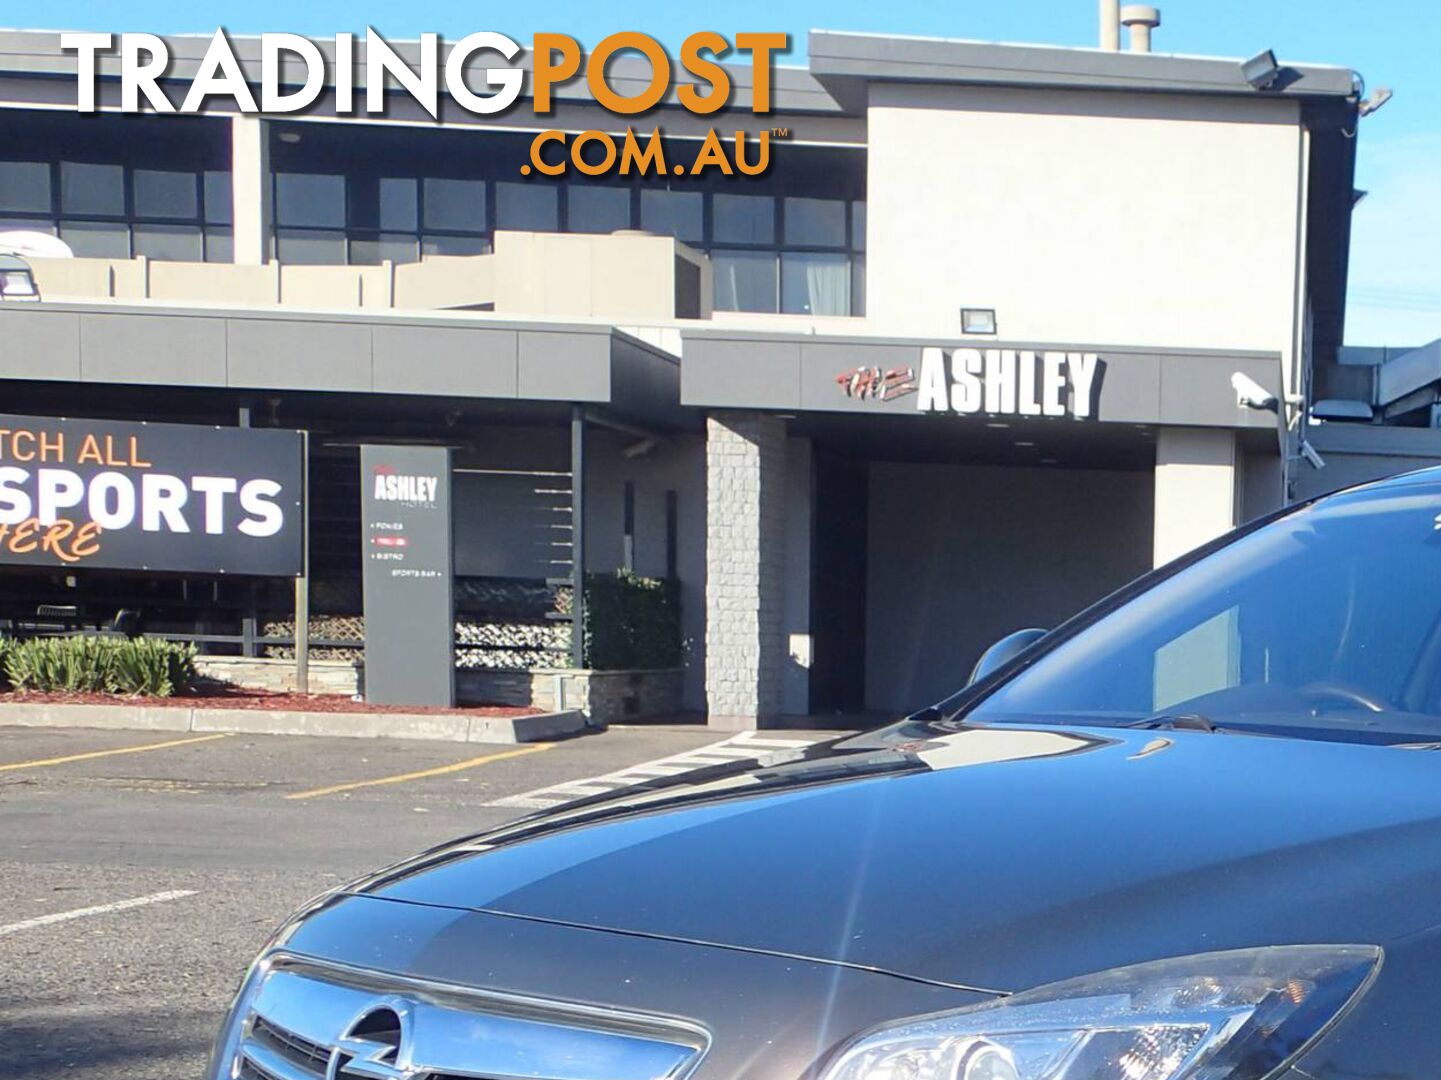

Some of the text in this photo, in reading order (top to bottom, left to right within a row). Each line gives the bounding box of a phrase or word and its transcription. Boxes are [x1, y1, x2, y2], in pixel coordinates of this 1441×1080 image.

[917, 347, 1100, 418] ASHLEY
[77, 434, 152, 467] ALL
[0, 466, 284, 537] SPORTS
[374, 475, 438, 502] ASHLEY
